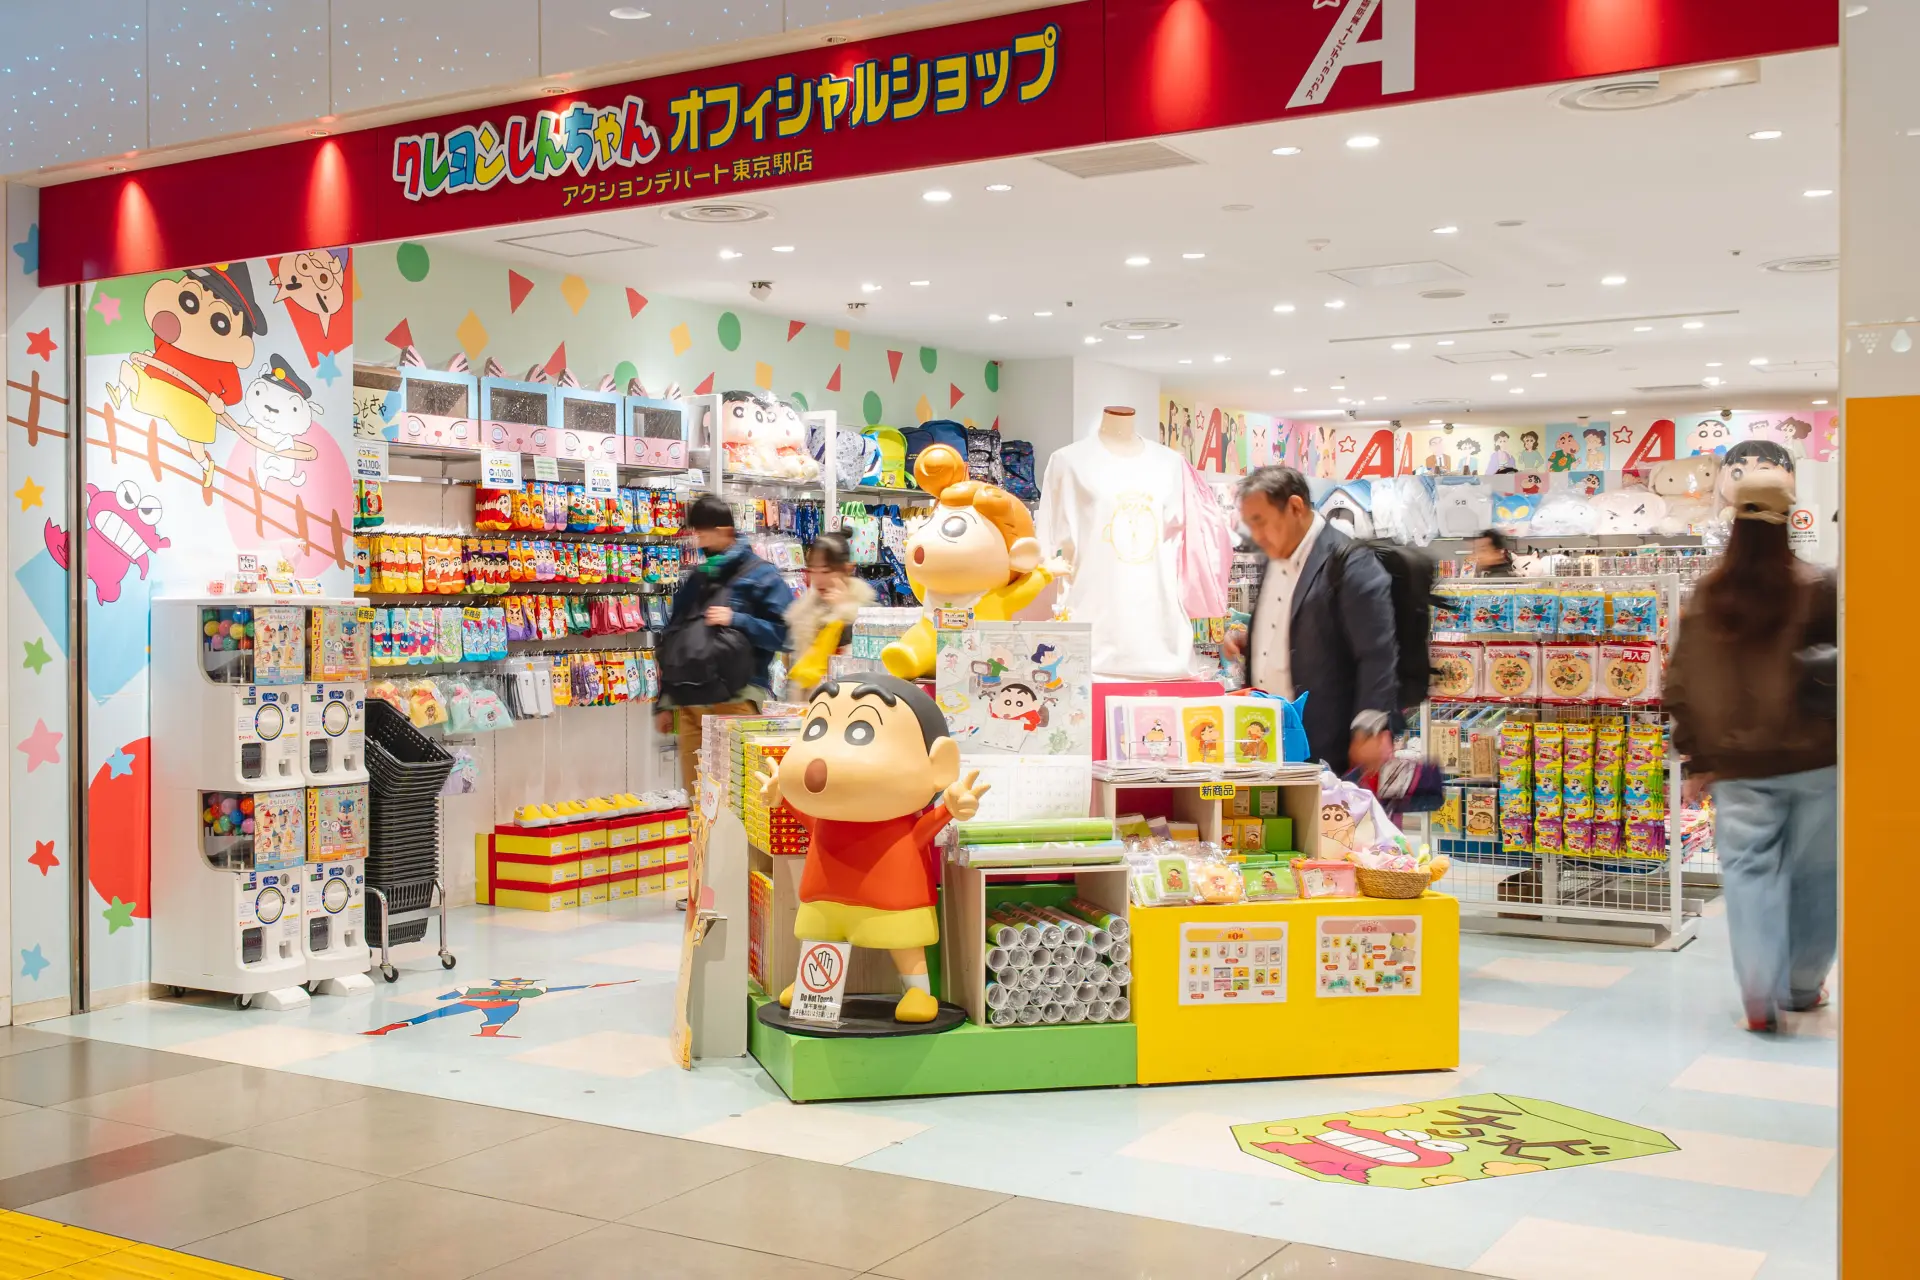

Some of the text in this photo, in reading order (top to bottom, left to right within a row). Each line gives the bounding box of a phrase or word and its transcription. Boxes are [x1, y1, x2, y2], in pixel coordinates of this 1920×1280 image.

[394, 22, 1063, 201] クレヨンしんちゃん オフィシャルショップ
[562, 148, 814, 207] アクションデパート東京駅店
[358, 608, 375, 620] 新商品
[463, 608, 481, 620] 新商品
[1623, 650, 1650, 662] 再入荷
[1202, 785, 1234, 797] 新商品
[800, 993, 833, 1003] Do Not Touch
